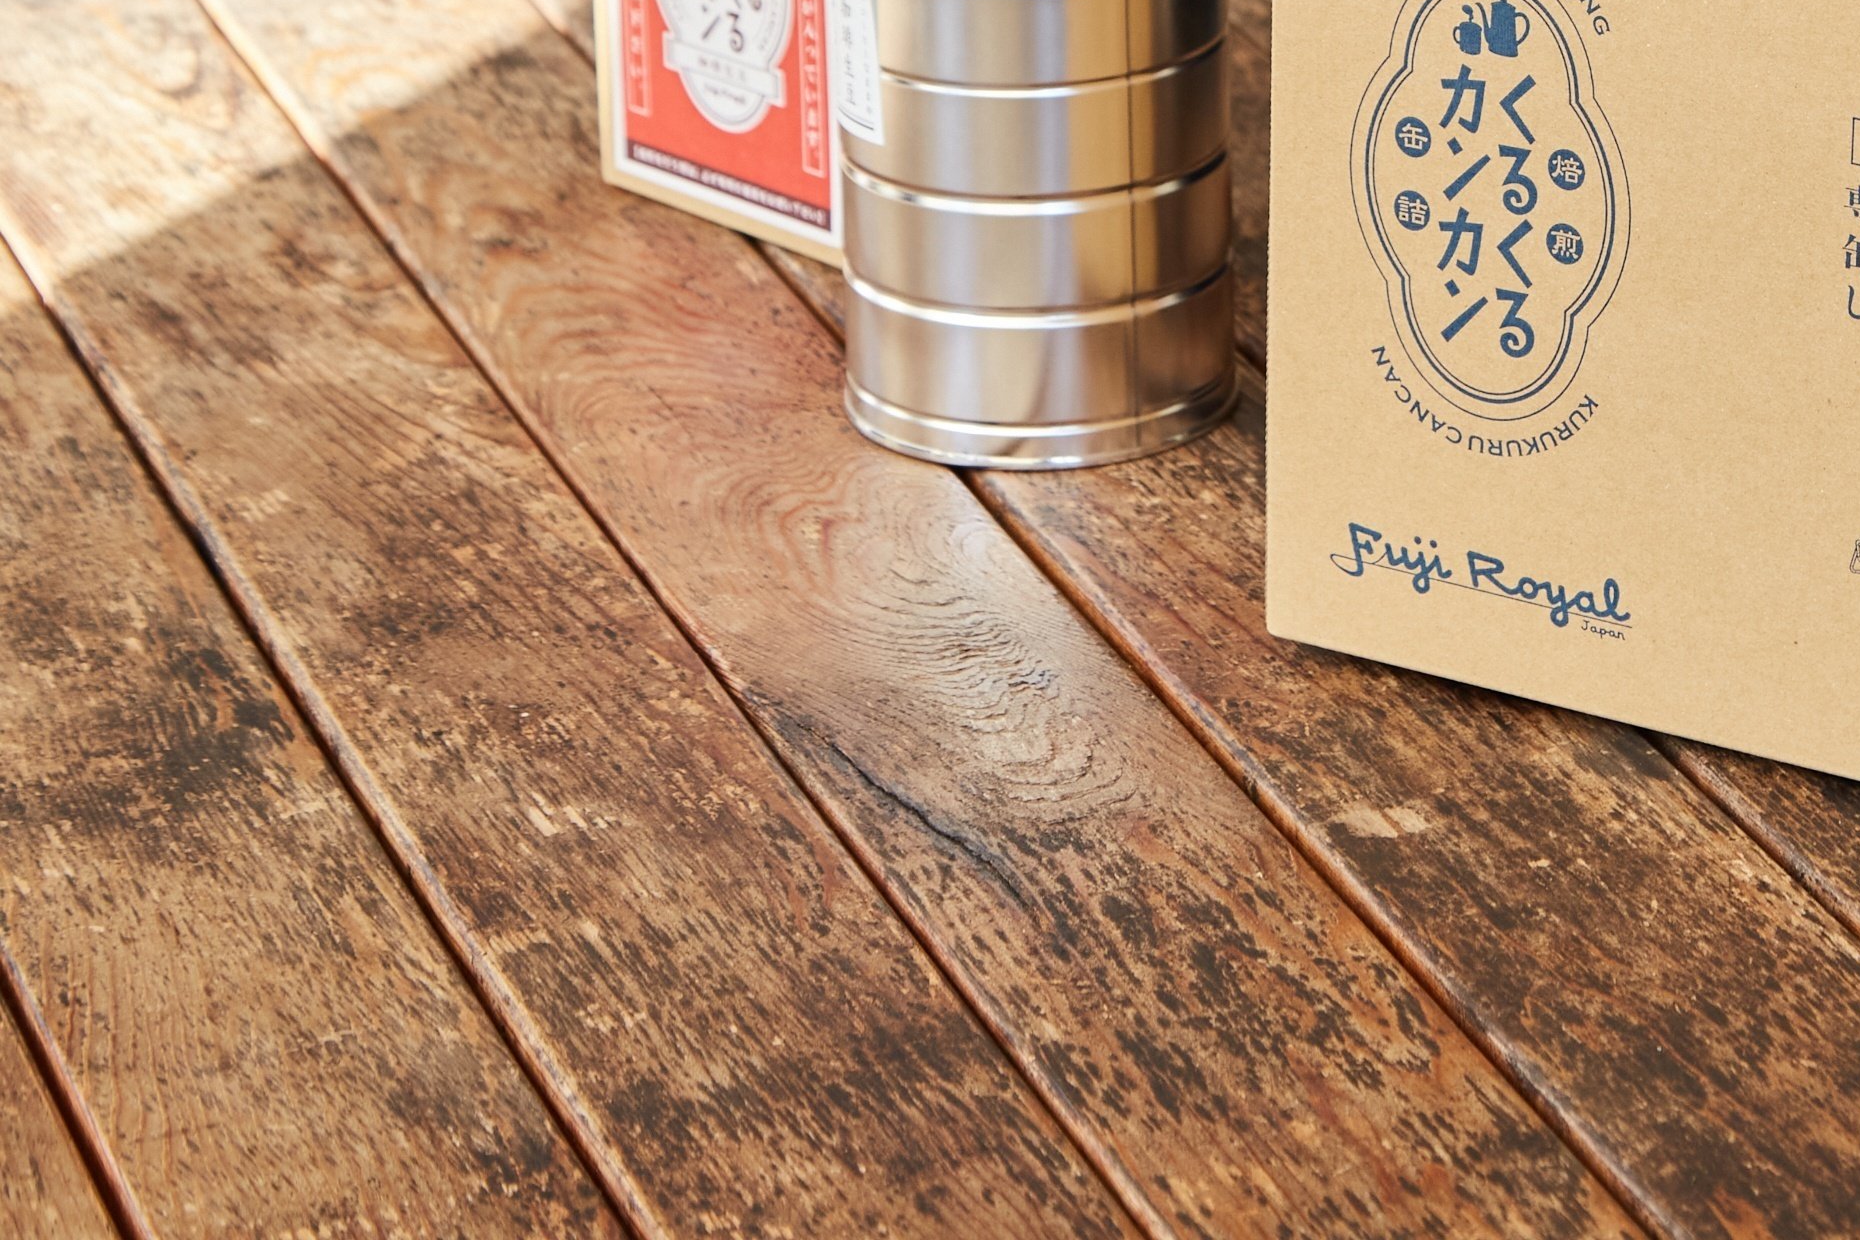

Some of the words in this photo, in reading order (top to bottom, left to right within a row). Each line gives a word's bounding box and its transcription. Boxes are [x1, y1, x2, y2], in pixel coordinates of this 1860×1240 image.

[1436, 64, 1492, 343] カンカン
[1495, 73, 1539, 359] くるくる
[1370, 345, 1463, 445] CANCAN
[1467, 394, 1599, 458] KURUKURU
[1330, 522, 1453, 594] Fuji
[1464, 550, 1631, 628] Royal
[1581, 620, 1626, 641] Japan
